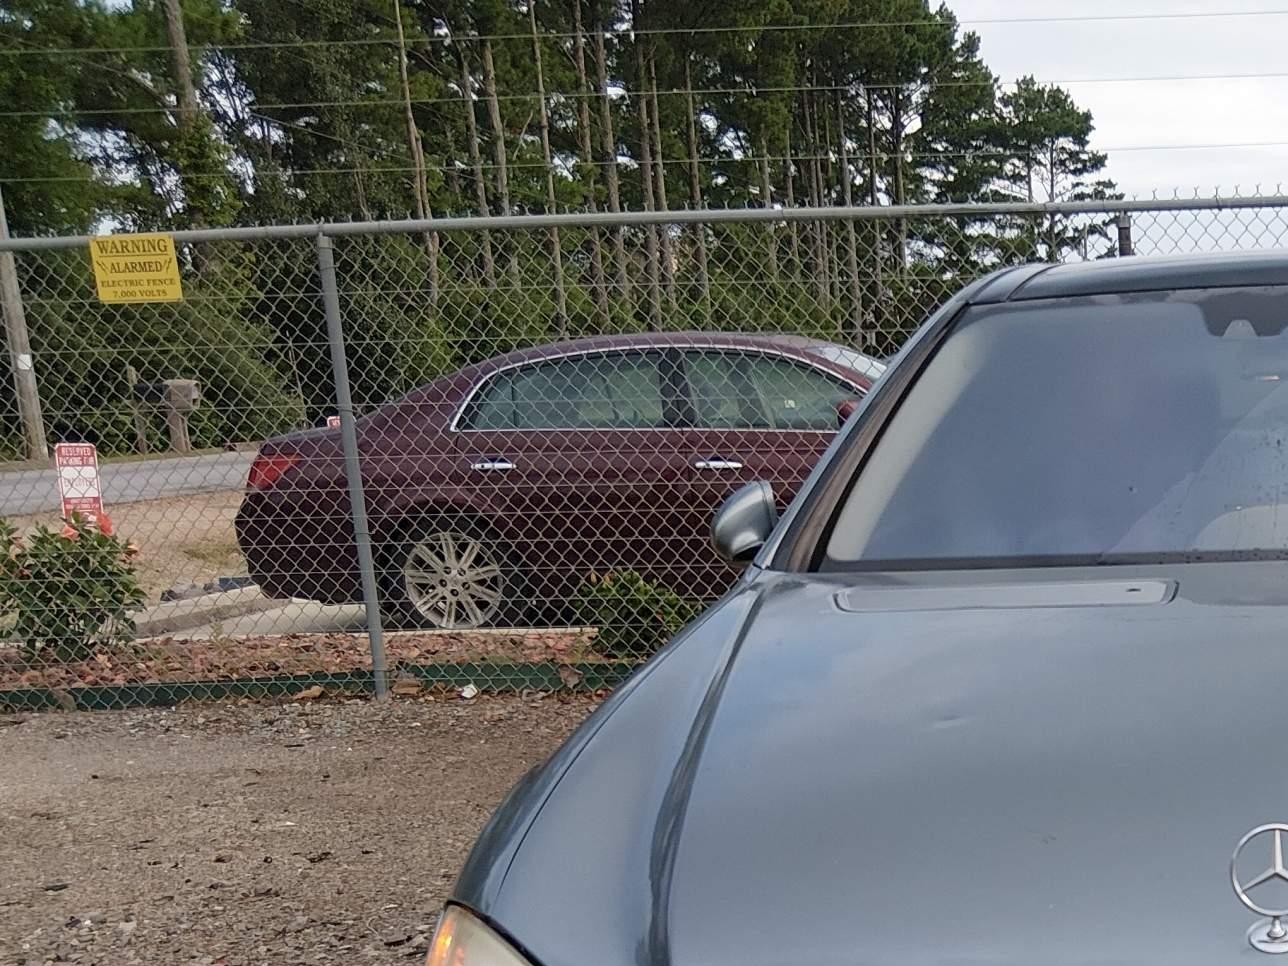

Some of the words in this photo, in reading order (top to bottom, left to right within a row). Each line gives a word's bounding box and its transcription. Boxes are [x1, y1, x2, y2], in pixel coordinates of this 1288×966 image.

[96, 239, 168, 254] WARNING
[110, 261, 162, 274] ALARMED
[101, 279, 145, 288] ELECTRIC
[147, 278, 176, 287] FENCE
[138, 289, 167, 297] VOLTS
